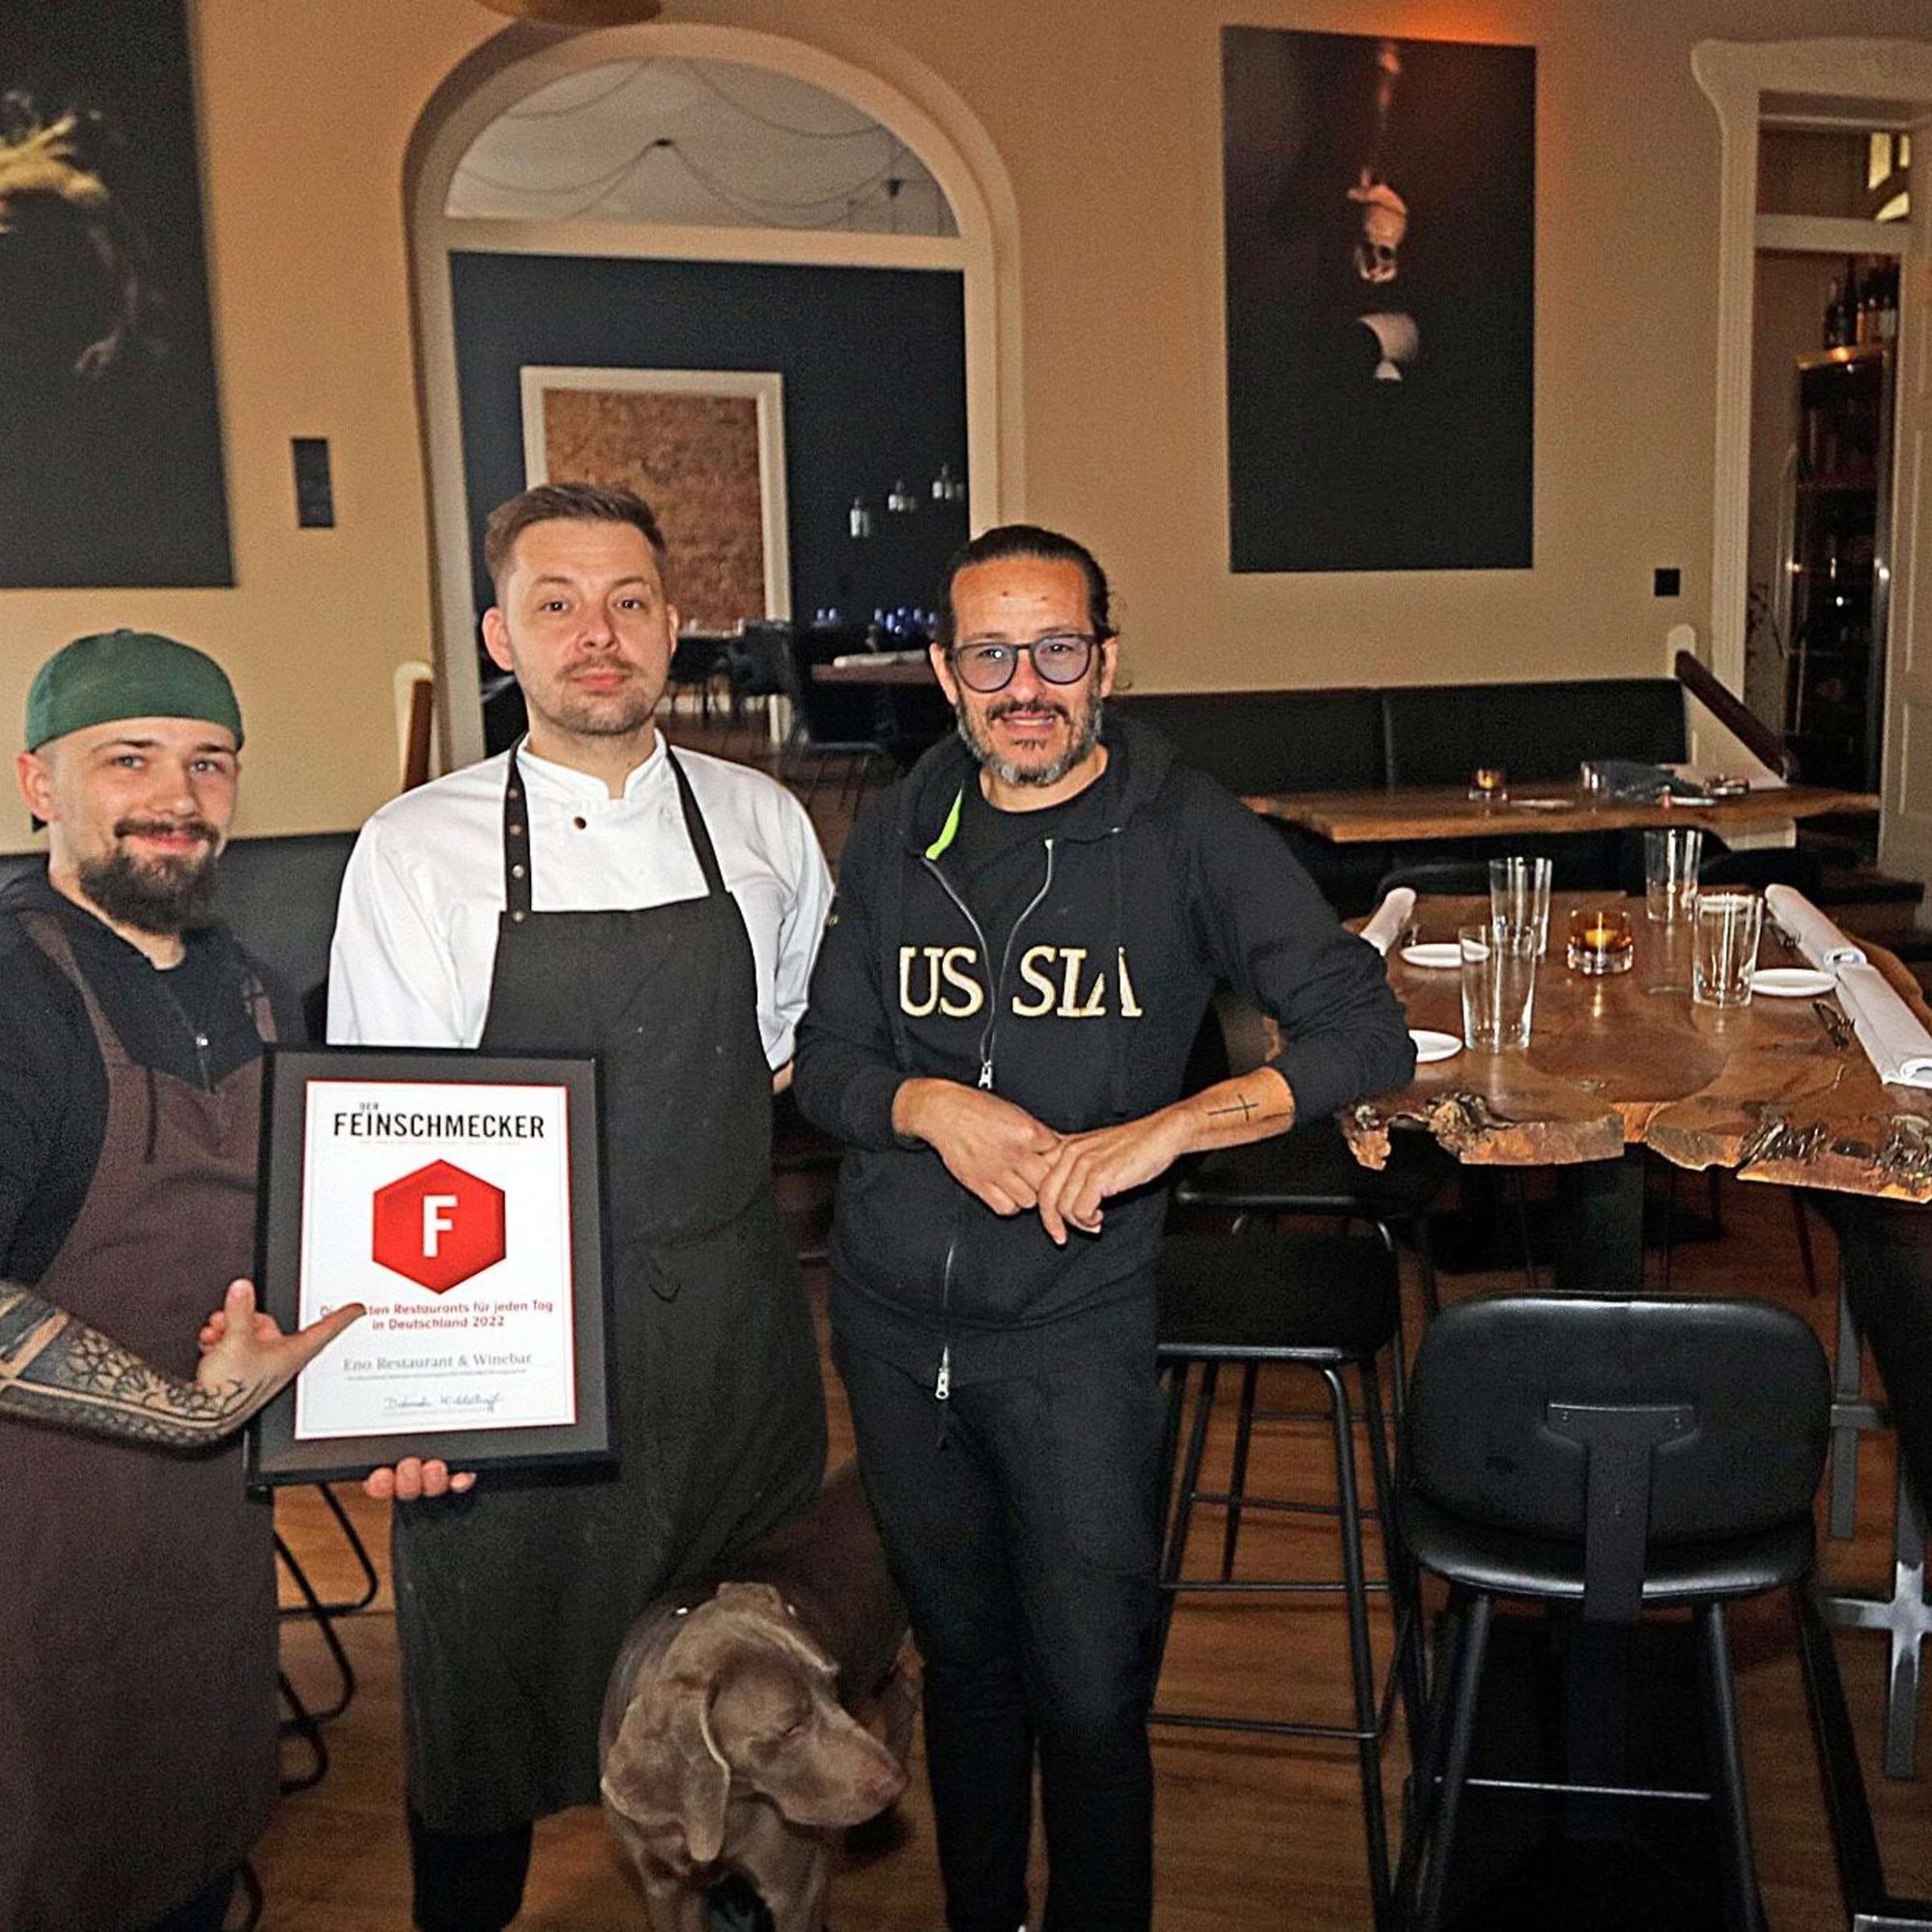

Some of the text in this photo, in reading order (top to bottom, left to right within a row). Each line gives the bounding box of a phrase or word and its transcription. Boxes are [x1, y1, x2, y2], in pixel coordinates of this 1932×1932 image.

[333, 1112, 545, 1138] FEINSCHMECKER
[423, 1195, 458, 1257] F
[393, 1302, 469, 1314] Restaurants
[473, 1300, 490, 1312] für
[494, 1300, 528, 1314] jeden
[532, 1299, 554, 1313] Tag
[372, 1315, 505, 1330] in Deutschland 2022
[343, 1351, 531, 1372] Eno Restaurant & Winebar
